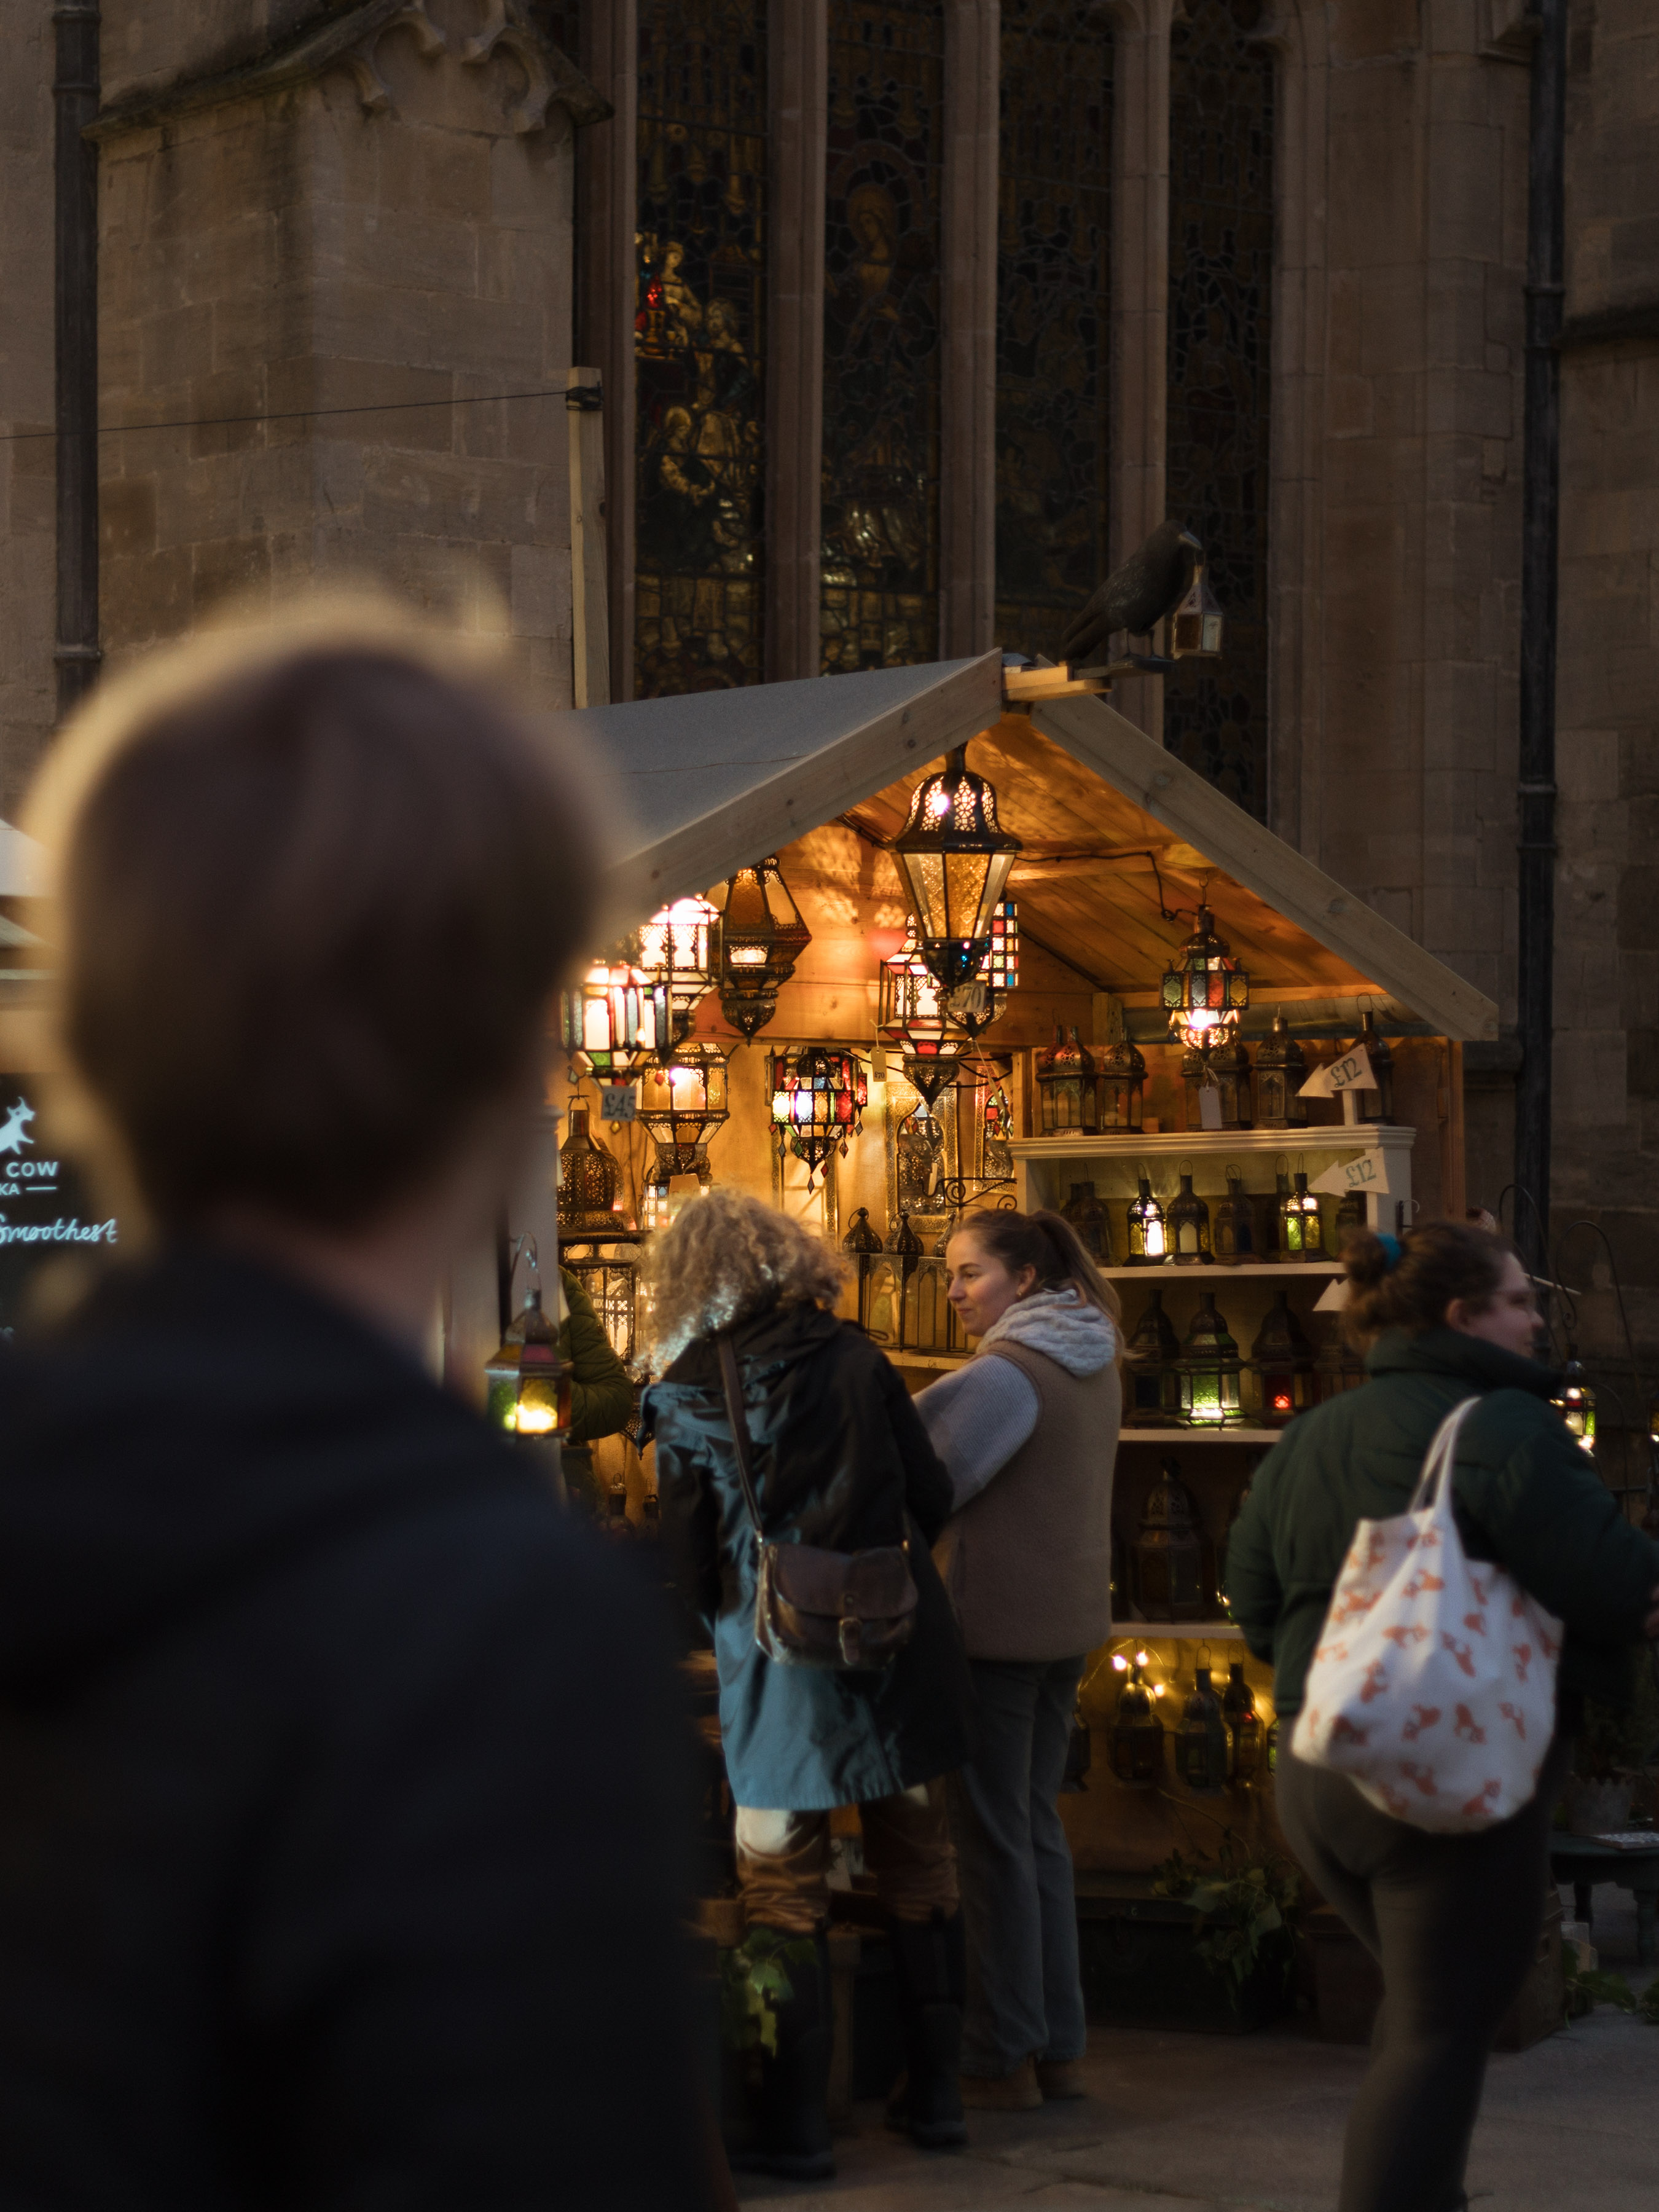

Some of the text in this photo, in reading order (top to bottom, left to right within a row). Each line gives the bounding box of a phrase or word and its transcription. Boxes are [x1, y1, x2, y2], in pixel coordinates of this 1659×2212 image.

[1331, 1057, 1362, 1088] £12
[604, 1093, 635, 1118] £45
[6, 1161, 58, 1178] COW
[1346, 1159, 1376, 1187] £12
